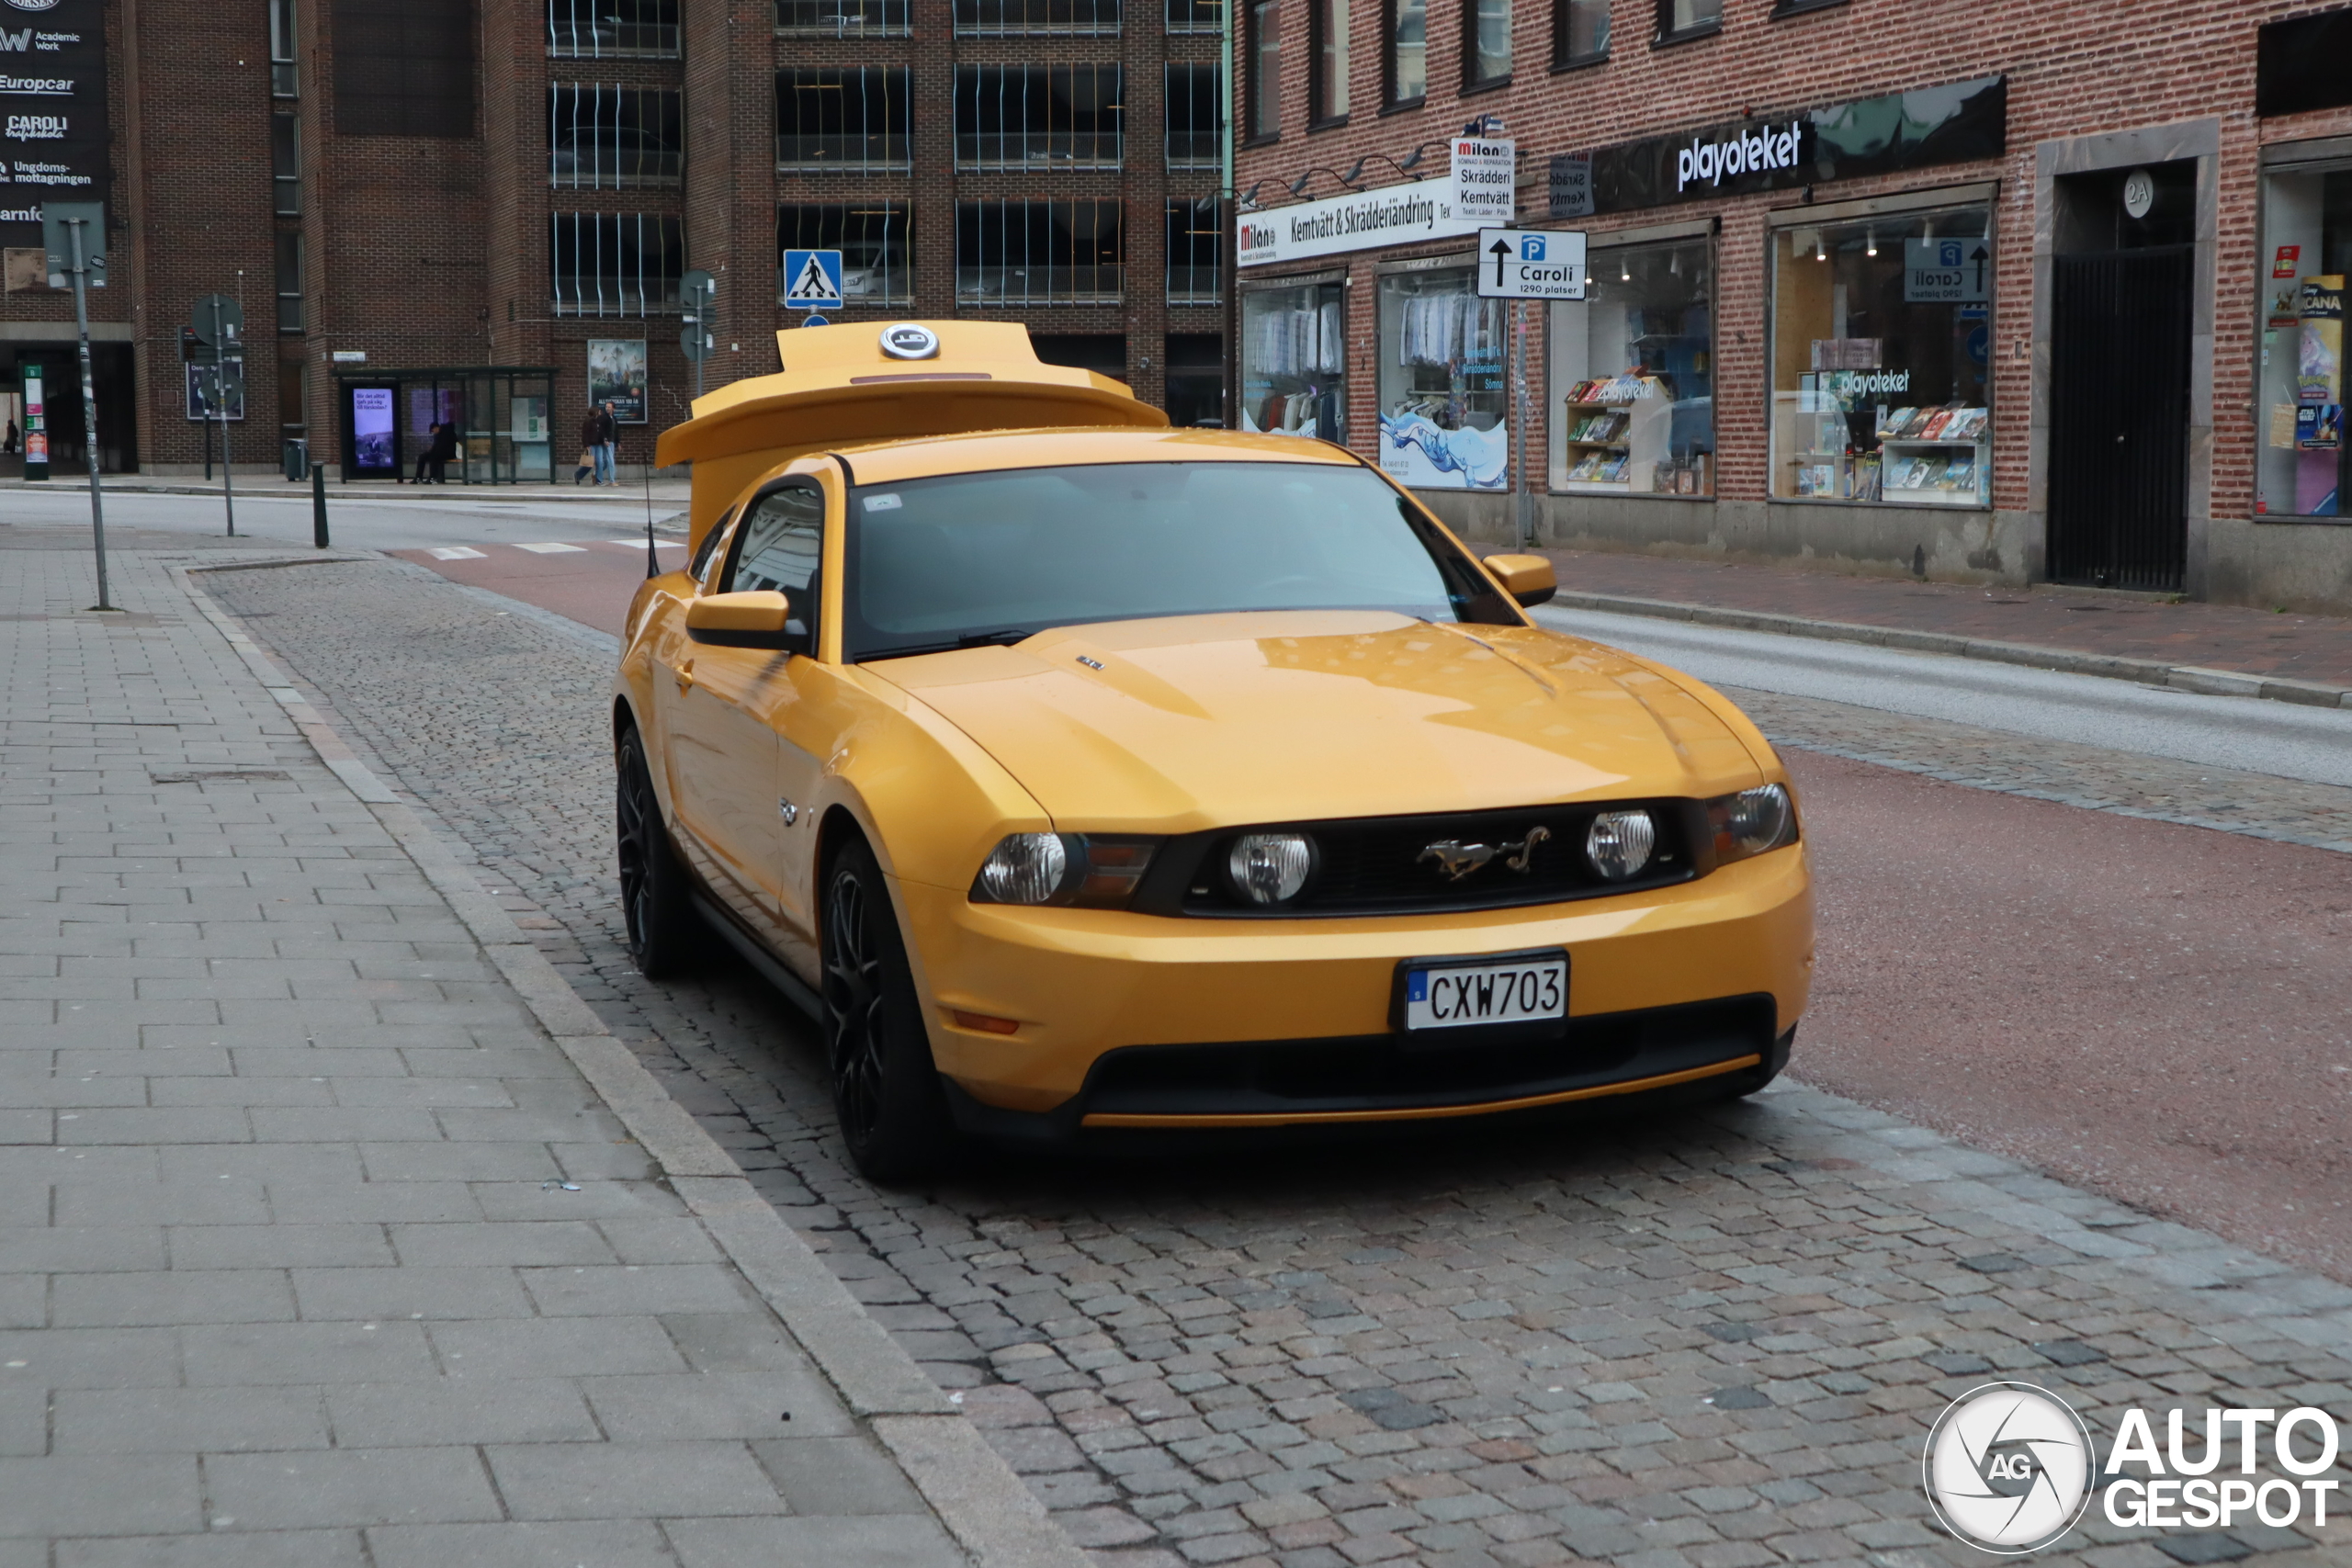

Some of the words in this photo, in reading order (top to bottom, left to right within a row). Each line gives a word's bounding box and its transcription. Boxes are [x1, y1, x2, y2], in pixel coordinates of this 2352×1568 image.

[36, 31, 80, 42] Academic
[36, 41, 60, 51] Work
[0, 75, 74, 93] Europcar
[7, 116, 68, 130] CAROLI
[6, 128, 65, 142] trafikskola
[1483, 158, 1511, 166] REPARATION
[1678, 120, 1802, 192] playoteket
[14, 162, 71, 174] Ungdoms-
[1461, 168, 1510, 185] Skrädderi
[15, 174, 92, 186] mottagningen
[1461, 189, 1510, 205] Kemtvätt
[2129, 182, 2150, 204] 2A
[1291, 210, 1334, 243] Kemtvätt
[1336, 208, 1343, 236] &
[1345, 194, 1434, 234] Skrädderiändring
[1528, 242, 1541, 260] P
[1521, 265, 1573, 282] Caroli
[1521, 285, 1543, 293] 1290
[1545, 286, 1577, 295] platser
[1601, 379, 1655, 404] playoteket
[1840, 368, 1910, 398] playoteket
[1414, 990, 1421, 1000] S
[1431, 967, 1560, 1020] CXW703
